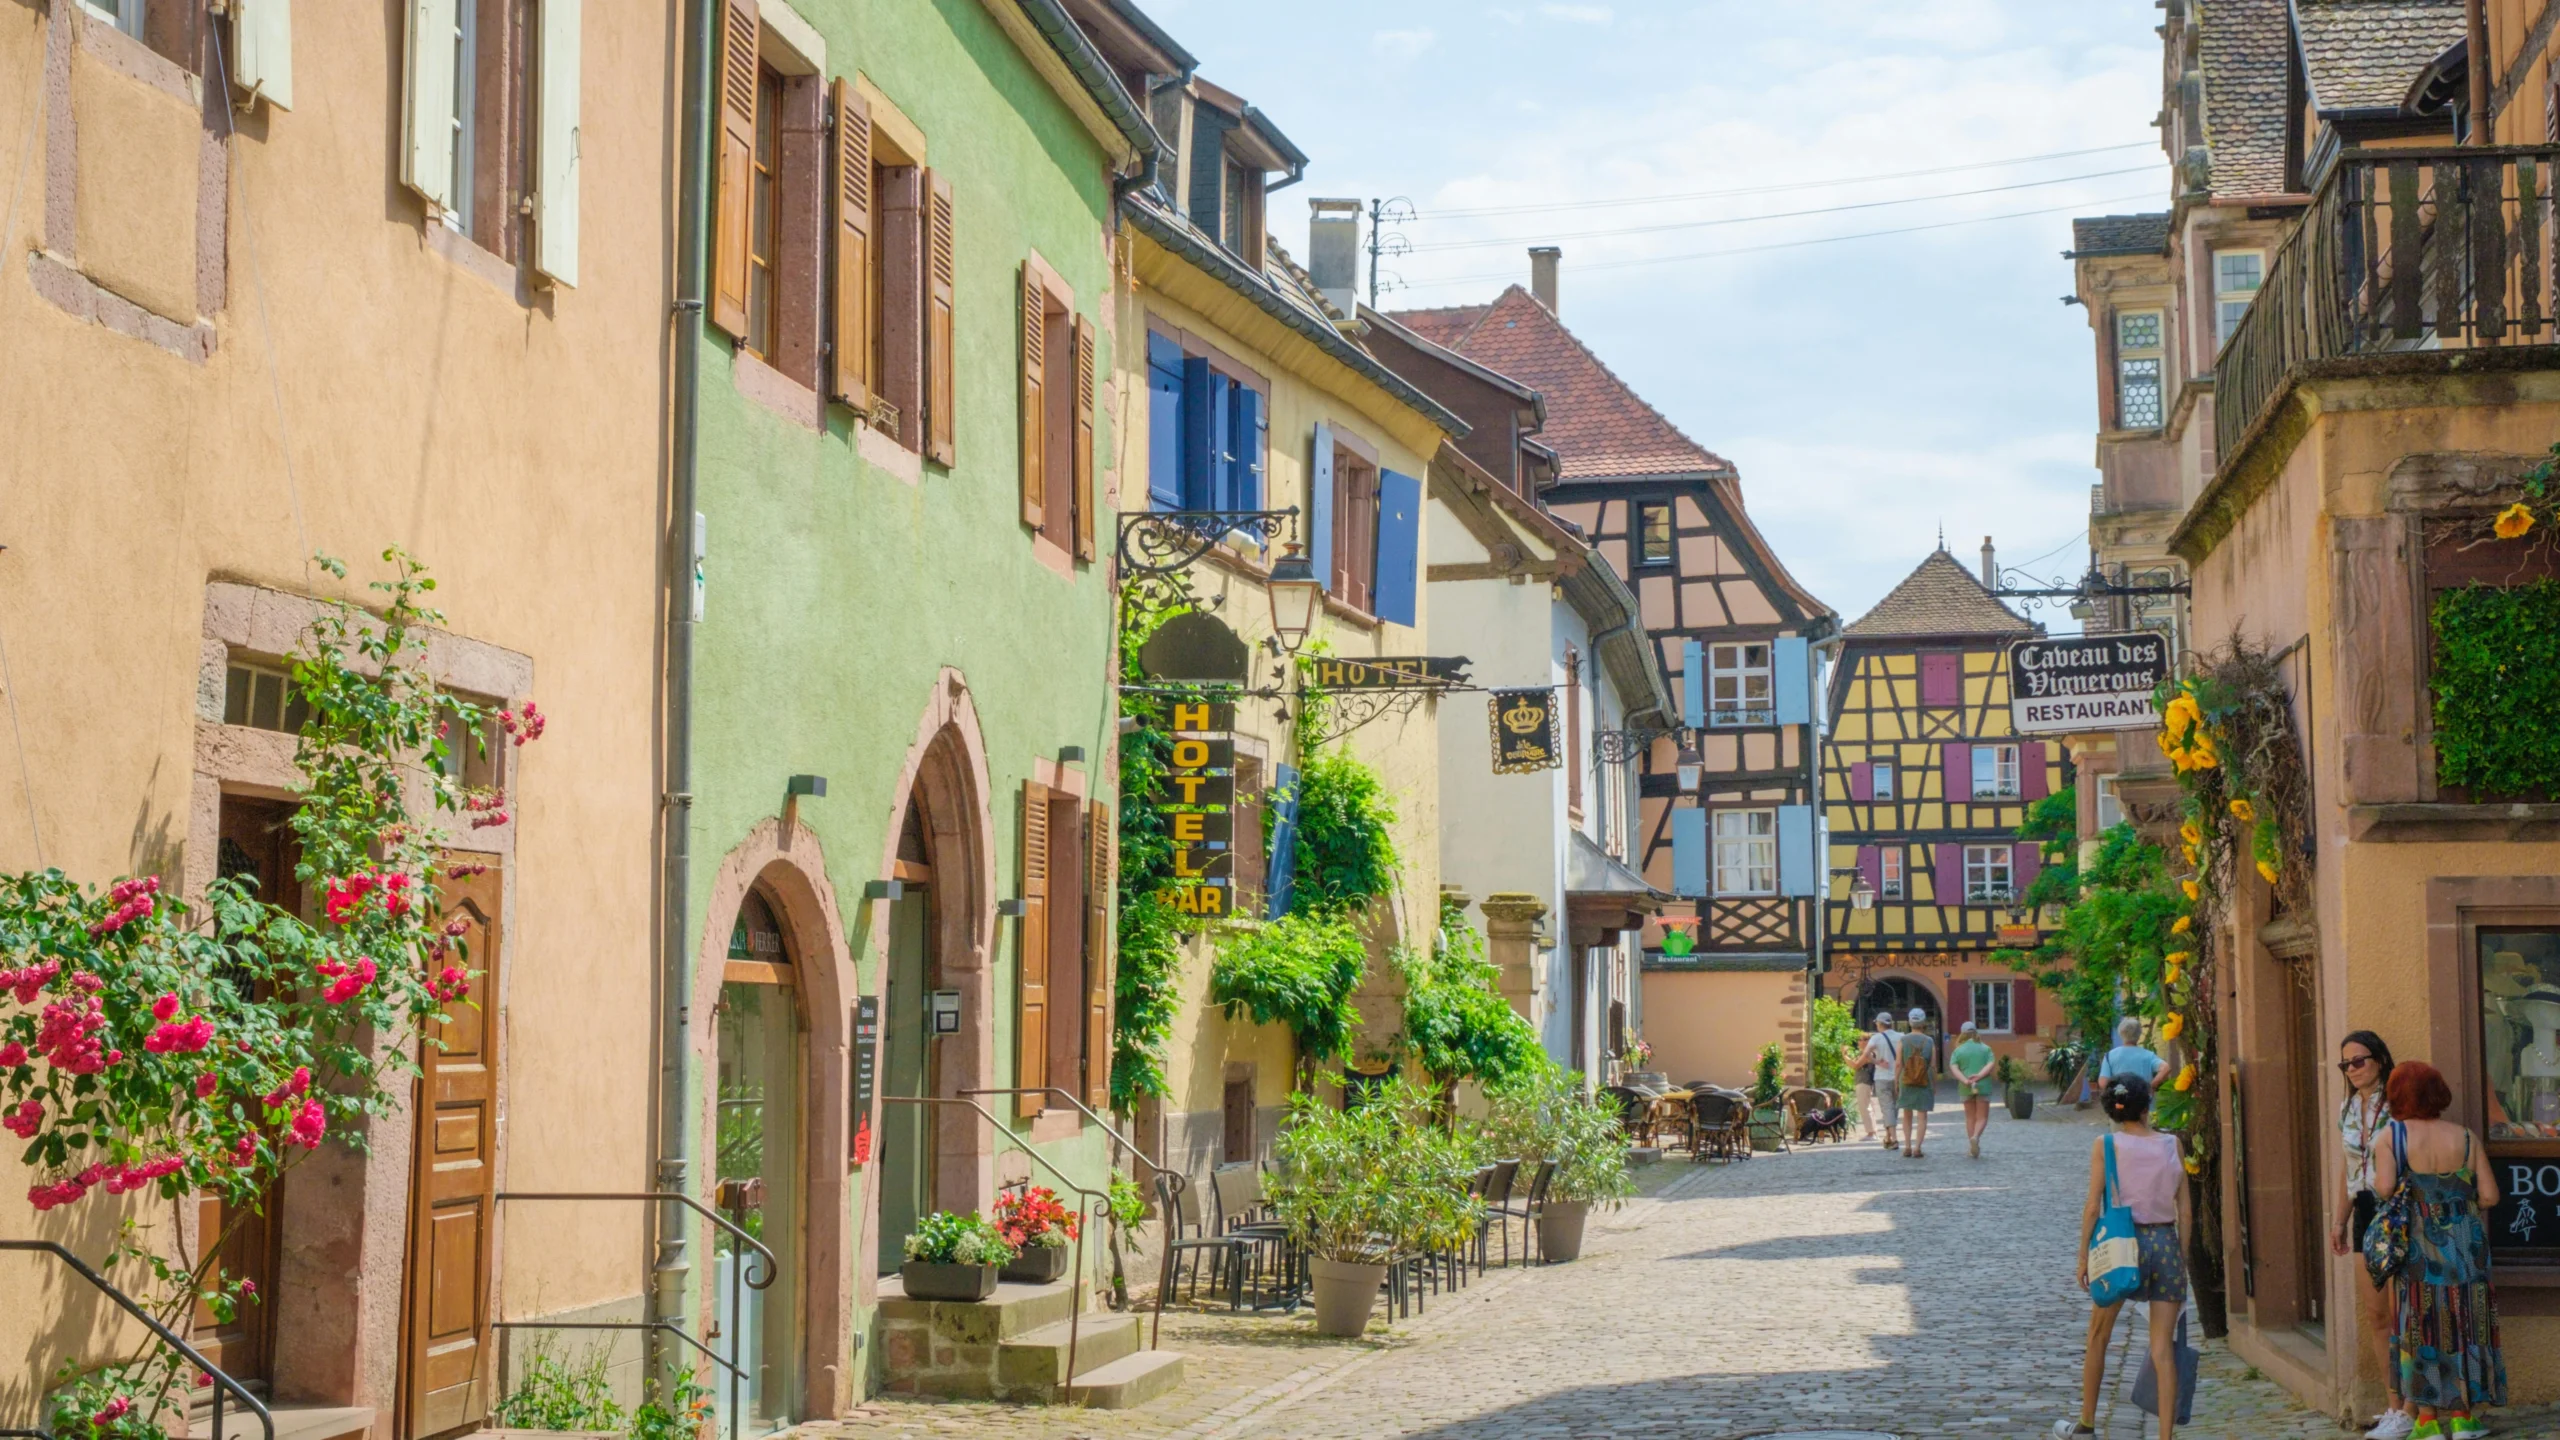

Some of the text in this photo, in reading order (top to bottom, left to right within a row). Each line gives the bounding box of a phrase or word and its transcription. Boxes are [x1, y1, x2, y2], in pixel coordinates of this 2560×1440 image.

[2019, 642, 2158, 670] Caveau des
[1321, 660, 1442, 685] HOTEL
[2025, 669, 2155, 696] Vignerons
[2027, 698, 2155, 722] RESTAURANT
[1173, 703, 1210, 877] HOTEL
[1658, 955, 1697, 963] Restaurant
[1868, 954, 1958, 967] BOULANGERIE
[2508, 1165, 2560, 1196] BO
